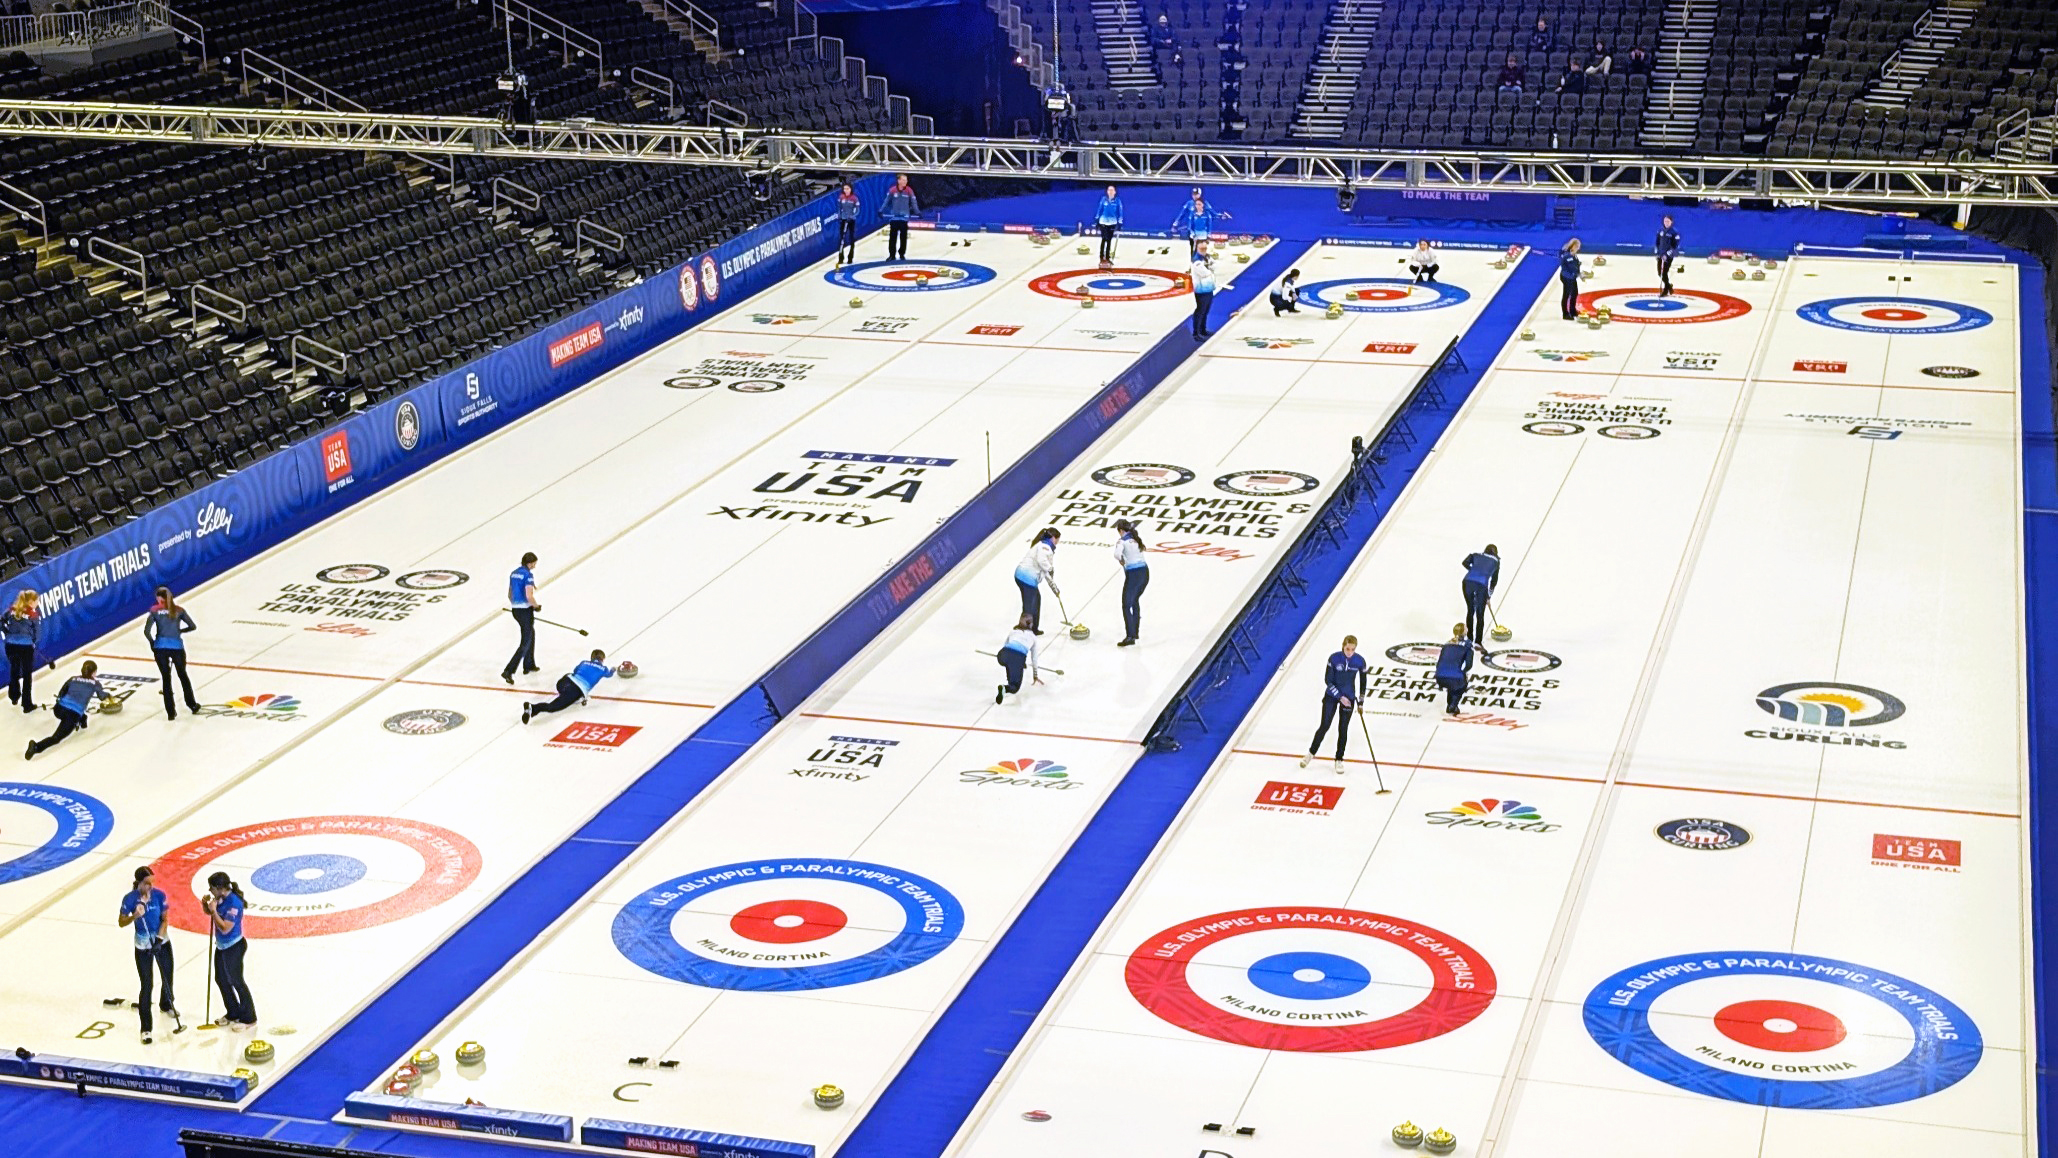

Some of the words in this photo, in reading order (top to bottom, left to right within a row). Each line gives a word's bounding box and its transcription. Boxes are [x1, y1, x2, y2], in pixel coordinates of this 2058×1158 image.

[1402, 190, 1413, 198] TO
[1416, 191, 1441, 200] MAKE
[1444, 192, 1462, 200] THE
[1464, 192, 1490, 202] TEAM
[722, 260, 734, 280] U.S.
[734, 249, 756, 274] OLYMPIC
[760, 230, 792, 258] PARALYMPIC
[790, 224, 806, 244] TEAM
[804, 216, 822, 238] TRIALS
[618, 305, 644, 330] xfinity
[551, 340, 574, 364] MAKING
[572, 332, 590, 352] TEAM
[588, 326, 602, 344] USA
[694, 368, 768, 378] OLYMPIC
[695, 364, 806, 375] PARALYMPIC
[401, 406, 410, 414] USA
[458, 412, 476, 426] SPORTS
[475, 402, 498, 418] AUTHORITY
[460, 402, 478, 415] SIOUX
[478, 396, 492, 408] FALLS
[1538, 401, 1606, 410] TRIALS
[1538, 408, 1664, 418] PARALYMPIC
[1616, 404, 1668, 412] TEAM
[1543, 414, 1627, 422] OLYMPIC
[328, 440, 342, 452] TEAM
[328, 452, 347, 472] USA
[820, 452, 938, 465] MAKING
[806, 462, 928, 477] TEAM
[328, 482, 338, 494] ONE
[338, 480, 346, 489] FOR
[346, 476, 354, 485] ALL
[752, 472, 923, 504] USA
[762, 498, 850, 507] presented
[852, 502, 872, 510] by
[1056, 489, 1116, 502] U.S.
[1131, 494, 1278, 512] OLYMPIC
[1286, 503, 1312, 514] &
[196, 502, 233, 538] Lilly
[706, 506, 895, 528] xfinity
[1062, 502, 1284, 526] PARALYMPIC
[1048, 514, 1142, 530] TEAM
[1155, 521, 1280, 538] TRIALS
[158, 532, 184, 554] presented
[184, 529, 192, 540] by
[1144, 541, 1256, 562] Lilly
[74, 562, 109, 599] TEAM
[108, 543, 150, 582] TRIALS
[280, 584, 318, 595] U.S.
[327, 587, 426, 603] OLYMPIC
[426, 595, 448, 604] &
[867, 594, 888, 620] TO
[908, 554, 933, 585] THE
[258, 602, 322, 615] TEAM
[326, 607, 410, 622] TRIALS
[275, 594, 420, 612] PARALYMPIC
[1367, 666, 1412, 679] U.S.
[1542, 679, 1560, 689] &
[1366, 688, 1436, 702] TEAM
[1460, 696, 1542, 711] RIALS
[192, 704, 307, 722] Sports
[1442, 712, 1528, 732] Lilly
[566, 729, 618, 743] USA
[836, 736, 892, 745] MAKING
[1744, 730, 1907, 750] CURLING
[1772, 726, 1822, 734] SIOUX
[1830, 730, 1882, 738] FALLS
[831, 742, 886, 752] TEAM
[806, 748, 884, 768] USA
[788, 768, 870, 782] xfinity
[960, 770, 1084, 790] Sports
[0, 788, 74, 806] RALYMPIC
[1270, 790, 1324, 806] USA
[1283, 786, 1322, 794] TEAM
[65, 802, 94, 822] TEAM
[1425, 810, 1562, 834] Sports
[62, 820, 94, 848] TRIALS
[182, 846, 217, 860] U.S.
[214, 824, 297, 848] OLYMPIC
[320, 821, 432, 841] PARALYMPIC
[1664, 834, 1740, 850] CURLING
[1894, 839, 1938, 848] TEAM
[1886, 844, 1946, 861] USA
[258, 902, 336, 912] CORTINA
[650, 890, 683, 907] U.S.
[681, 867, 757, 894] OLYMPIC
[760, 866, 775, 874] &
[780, 864, 902, 886] PARALYMPIC
[897, 881, 930, 904] TEAM
[922, 900, 946, 934] TRIALS
[697, 938, 750, 960] MILANO
[753, 950, 832, 962] CORTINA
[1154, 940, 1182, 960] U.S.
[1180, 916, 1254, 946] OLYMPIC
[1259, 914, 1272, 924] &
[1276, 912, 1410, 936] PARALYMPIC
[1407, 930, 1452, 960] TEAM
[1445, 955, 1476, 990] TRIALS
[1220, 994, 1282, 1018] MILANO
[1286, 1009, 1369, 1021] CORTINA
[1608, 984, 1639, 1008] U.S.
[1636, 961, 1702, 993] OLYMPIC
[1702, 960, 1718, 968] &
[1723, 958, 1868, 984] PARALYMPIC
[1870, 978, 1924, 1006] TEAM
[1916, 1002, 1958, 1041] TRIALS
[75, 1021, 115, 1039] B
[1694, 1045, 1765, 1070] MILANO
[1771, 1060, 1858, 1074] CORTINA
[110, 1078, 144, 1090] PARALYMPIC
[146, 1082, 160, 1090] TEAM
[160, 1084, 180, 1094] TRIALS
[612, 1082, 653, 1102] C
[391, 1114, 420, 1126] MAKING
[420, 1117, 440, 1128] TEAM
[442, 1120, 457, 1130] USA
[484, 1124, 518, 1138] xfinity
[628, 1138, 658, 1150] MAKING
[658, 1141, 678, 1152] TEAM
[680, 1144, 696, 1155] USA
